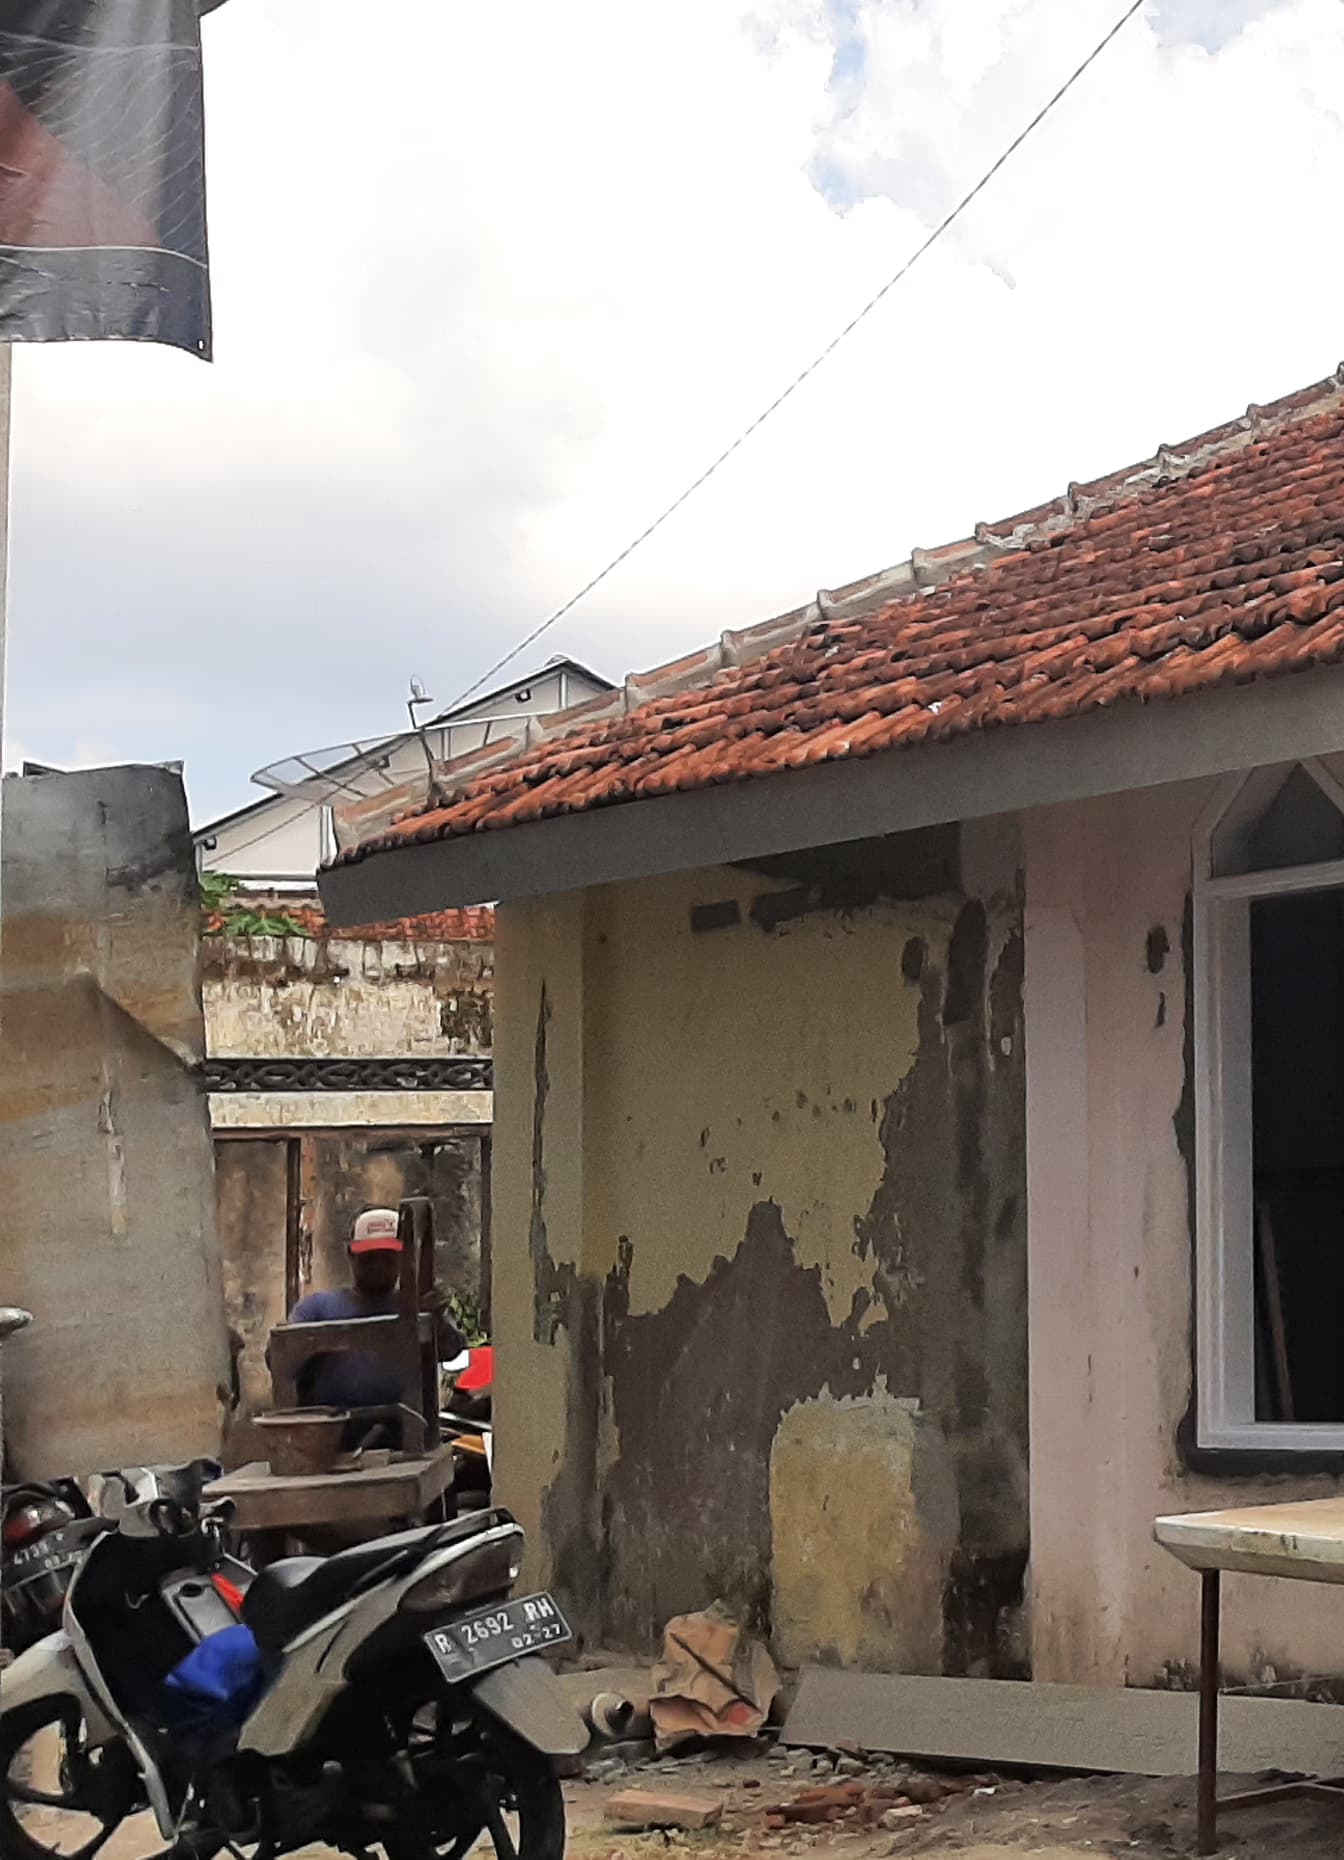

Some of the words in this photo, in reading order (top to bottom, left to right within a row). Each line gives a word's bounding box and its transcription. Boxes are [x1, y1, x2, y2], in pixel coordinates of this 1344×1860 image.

[434, 1633, 451, 1654] R
[461, 1612, 514, 1644] 2692
[523, 1597, 554, 1622] RH
